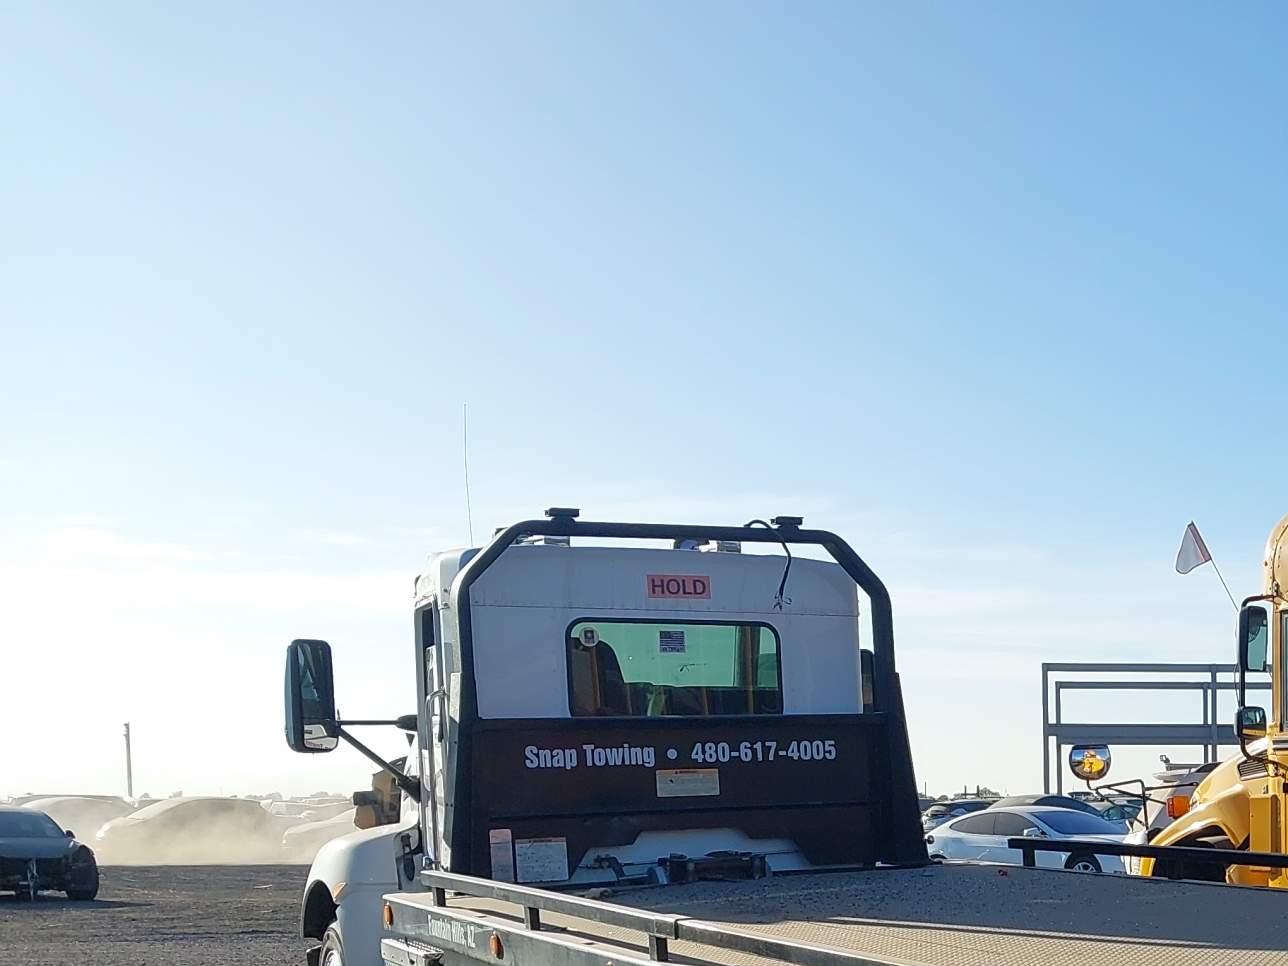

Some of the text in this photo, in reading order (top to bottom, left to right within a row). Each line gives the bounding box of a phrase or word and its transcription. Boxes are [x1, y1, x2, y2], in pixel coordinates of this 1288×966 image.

[651, 578, 706, 595] HOLD
[524, 740, 837, 770] Snap Towing 480-617-4005
